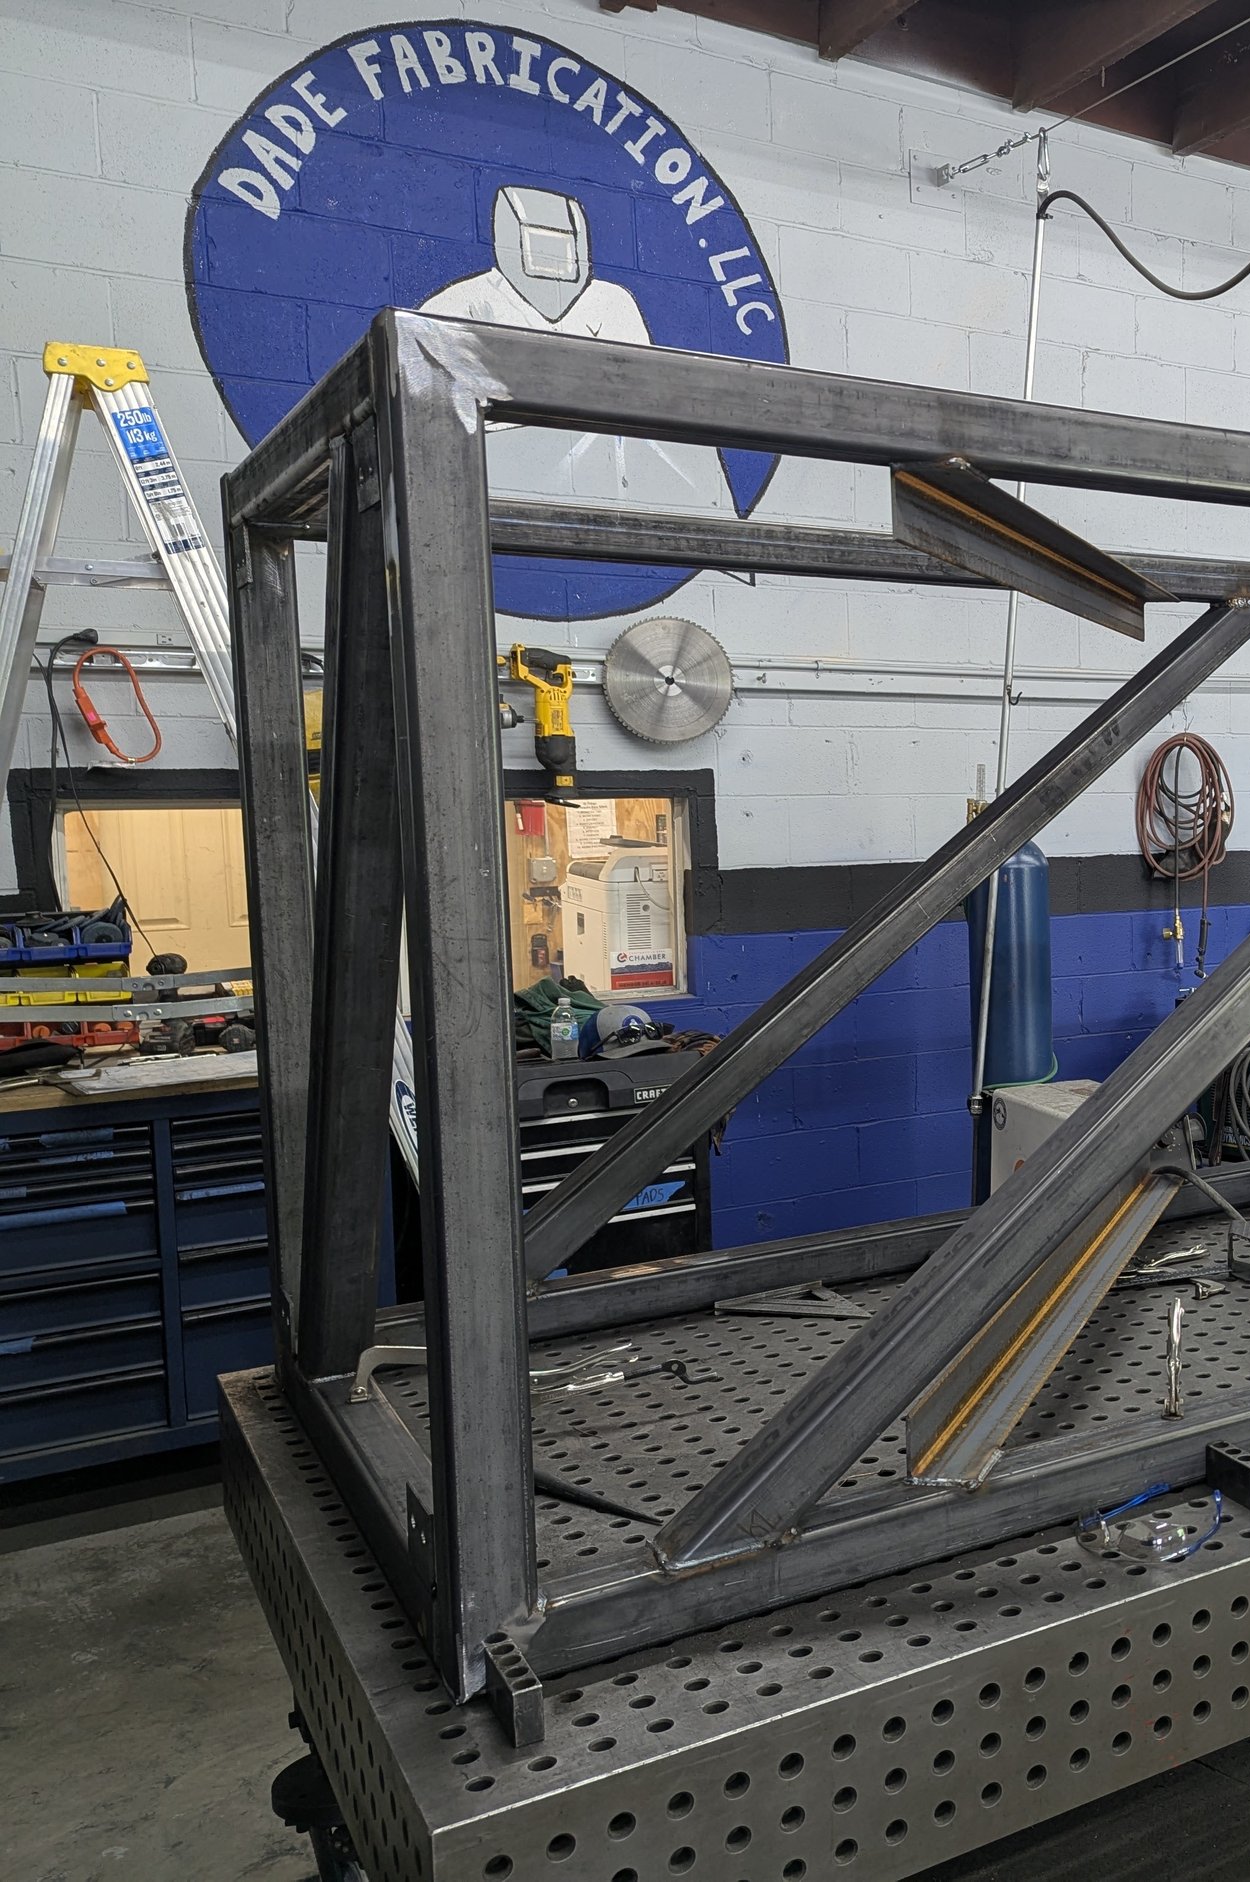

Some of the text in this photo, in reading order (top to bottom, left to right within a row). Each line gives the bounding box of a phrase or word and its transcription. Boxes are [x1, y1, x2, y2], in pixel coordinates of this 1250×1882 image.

[217, 73, 347, 220] DADE
[707, 246, 776, 336] LLC
[628, 954, 666, 962] CHAMBER
[635, 1188, 665, 1206] PADS
